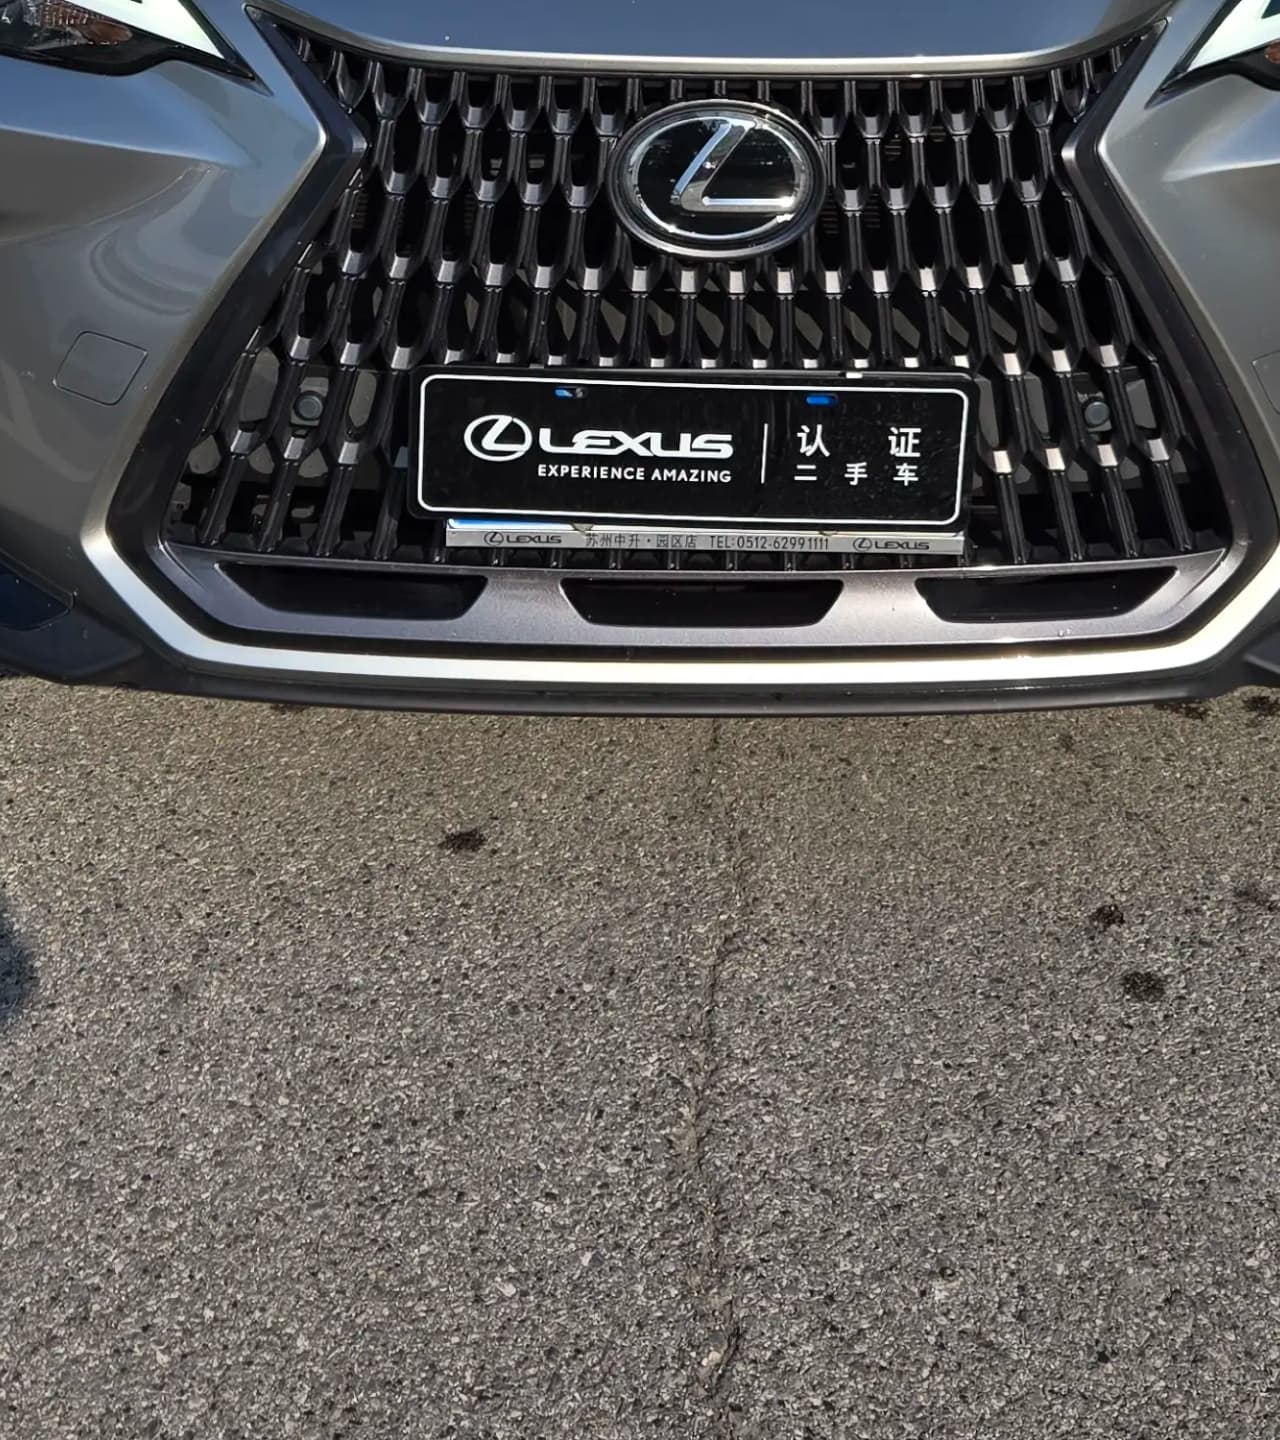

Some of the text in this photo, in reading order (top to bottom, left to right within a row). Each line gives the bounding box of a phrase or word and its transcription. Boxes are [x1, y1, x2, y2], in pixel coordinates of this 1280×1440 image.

[538, 427, 734, 459] LEXUS
[537, 464, 732, 483] EXPERIENCE AMAZING
[506, 534, 562, 544] LEXUS
[585, 532, 697, 549] 苏州中升·园区店
[874, 540, 930, 551] LEXUS
